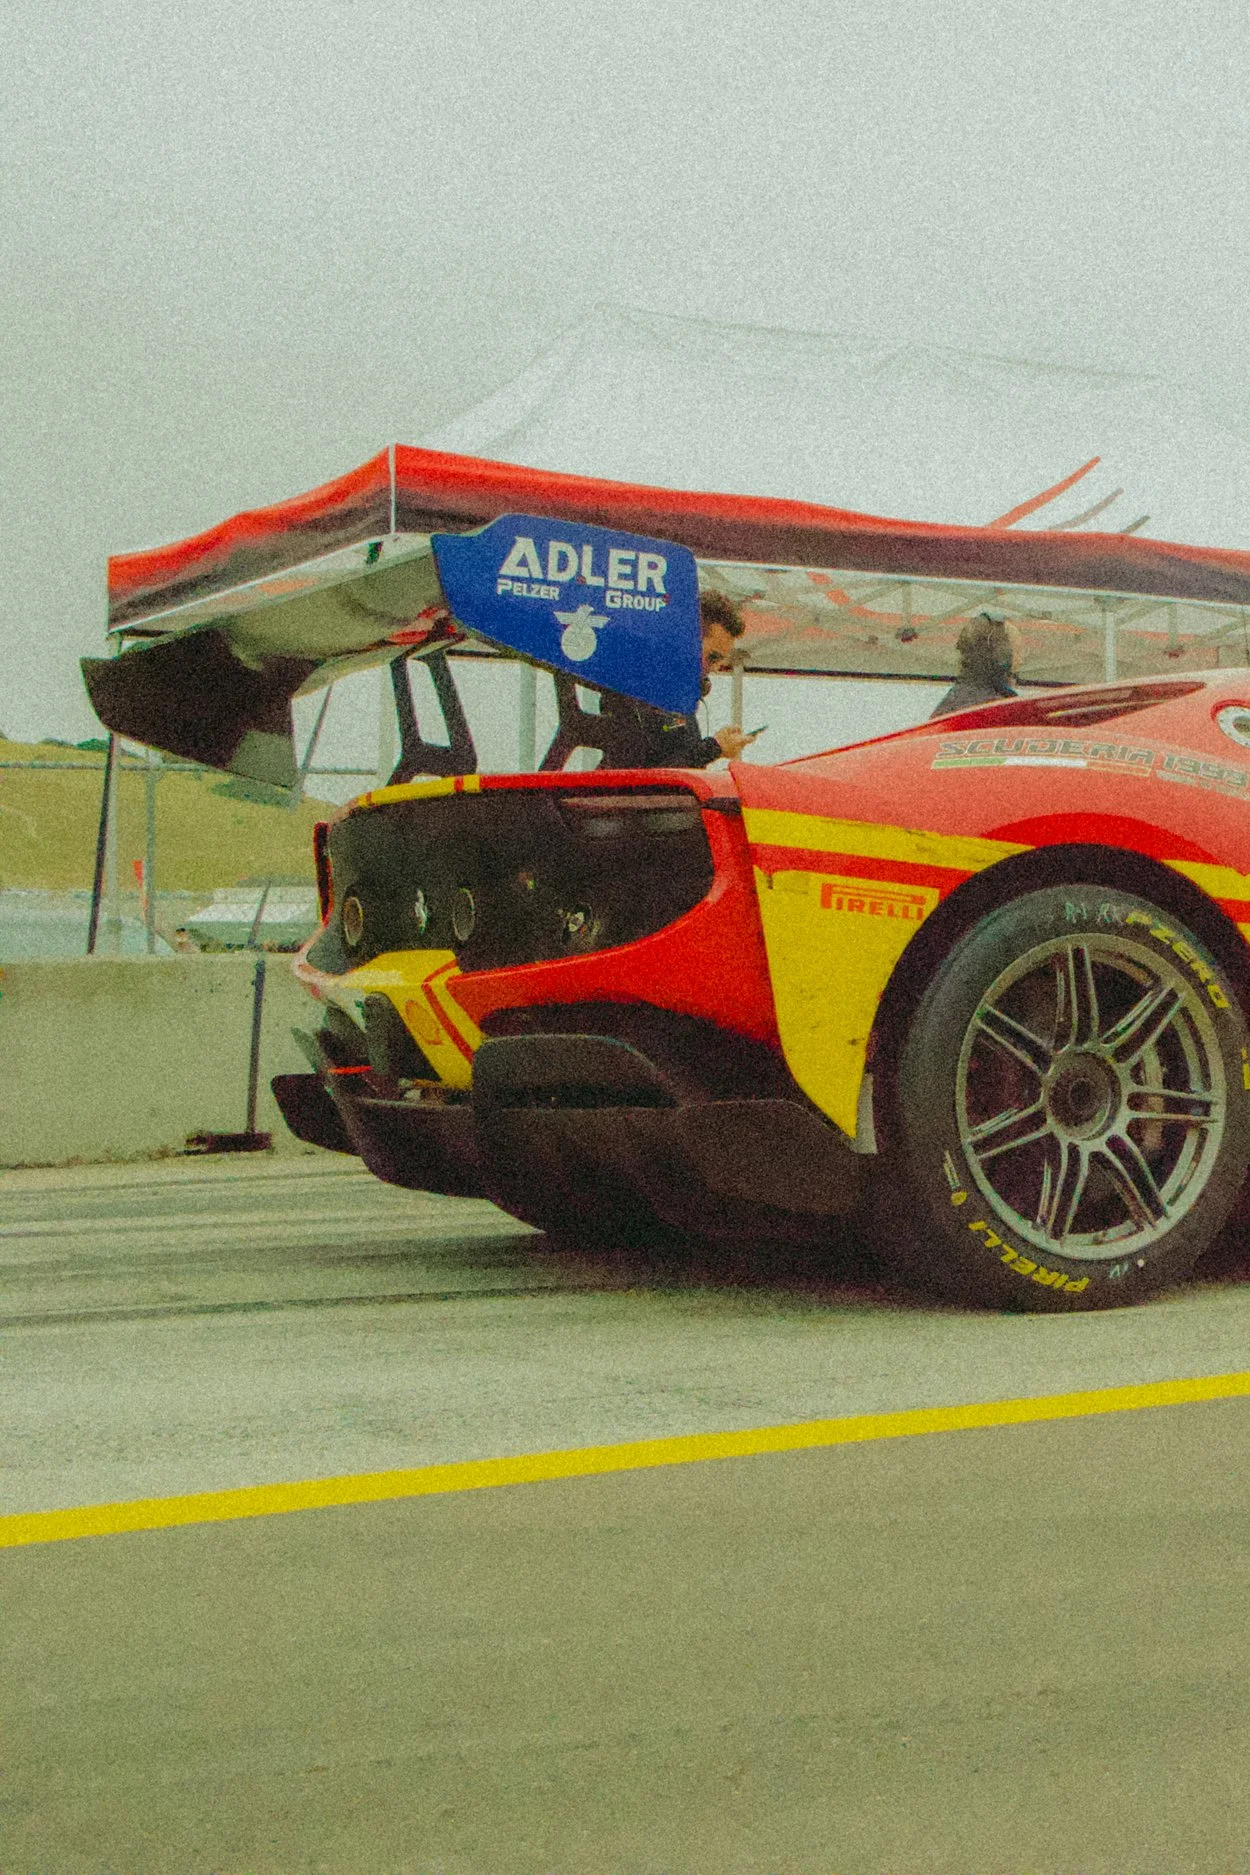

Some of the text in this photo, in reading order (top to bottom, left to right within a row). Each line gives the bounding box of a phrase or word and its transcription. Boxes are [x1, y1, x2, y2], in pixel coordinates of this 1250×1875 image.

[498, 535, 668, 594] ADLER
[497, 578, 668, 612] PELZER GROUP
[936, 738, 1155, 766] SCUDERIA
[820, 882, 926, 921] PIRELLI
[967, 1220, 1090, 1293] PIRELLI
